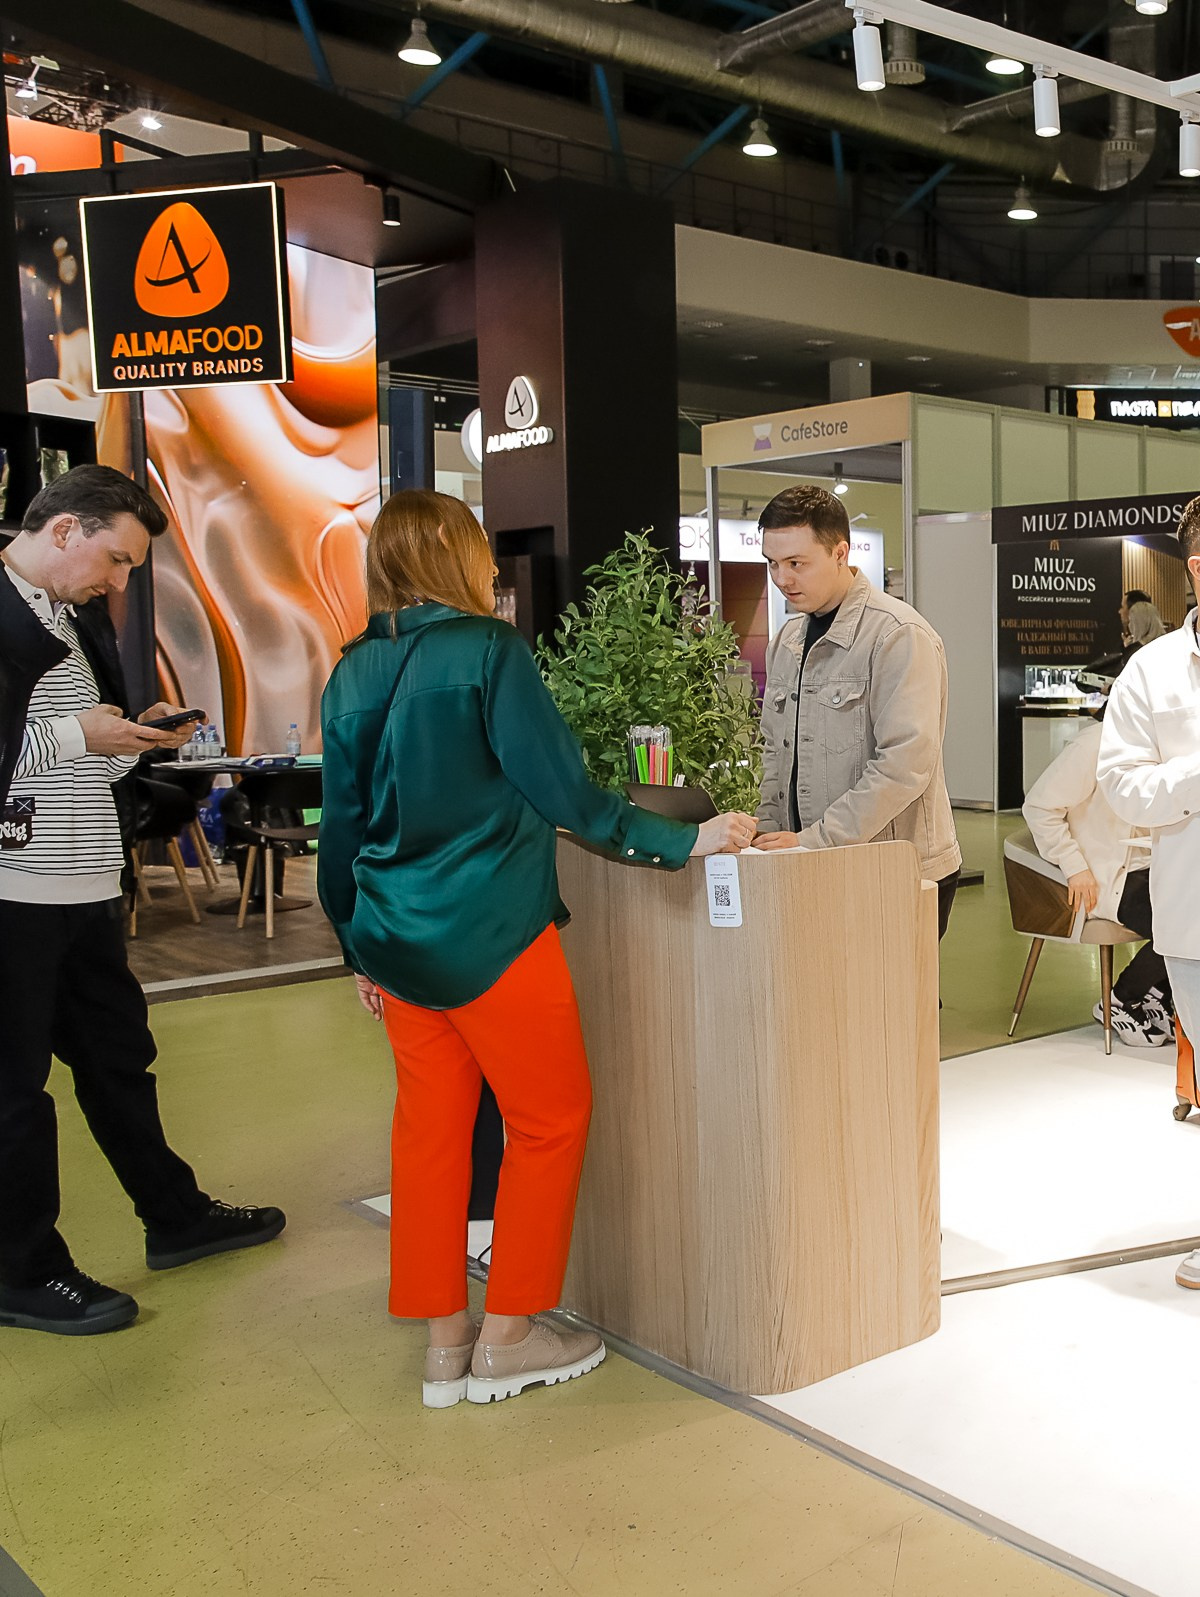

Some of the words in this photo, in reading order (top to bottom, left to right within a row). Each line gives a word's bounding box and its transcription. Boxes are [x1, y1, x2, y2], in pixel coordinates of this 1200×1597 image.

[111, 325, 263, 358] ALMAFOOD
[113, 362, 187, 380] QUALITY
[193, 357, 264, 377] BRANDS
[1110, 400, 1157, 417] ПАСТА
[486, 426, 549, 453] ALMAFOOD
[781, 420, 848, 442] CafeStore
[1022, 513, 1067, 532] MIUZ
[1074, 505, 1182, 530] DIAMONDS
[1034, 557, 1075, 575] MIUZ
[1012, 574, 1096, 592] DIAMONDS
[1001, 618, 1052, 629] ЮВЕЛИРНАЯ
[1068, 632, 1094, 642] ВКЛАД
[1021, 645, 1027, 655] В
[1028, 645, 1051, 655] ВАШЕ
